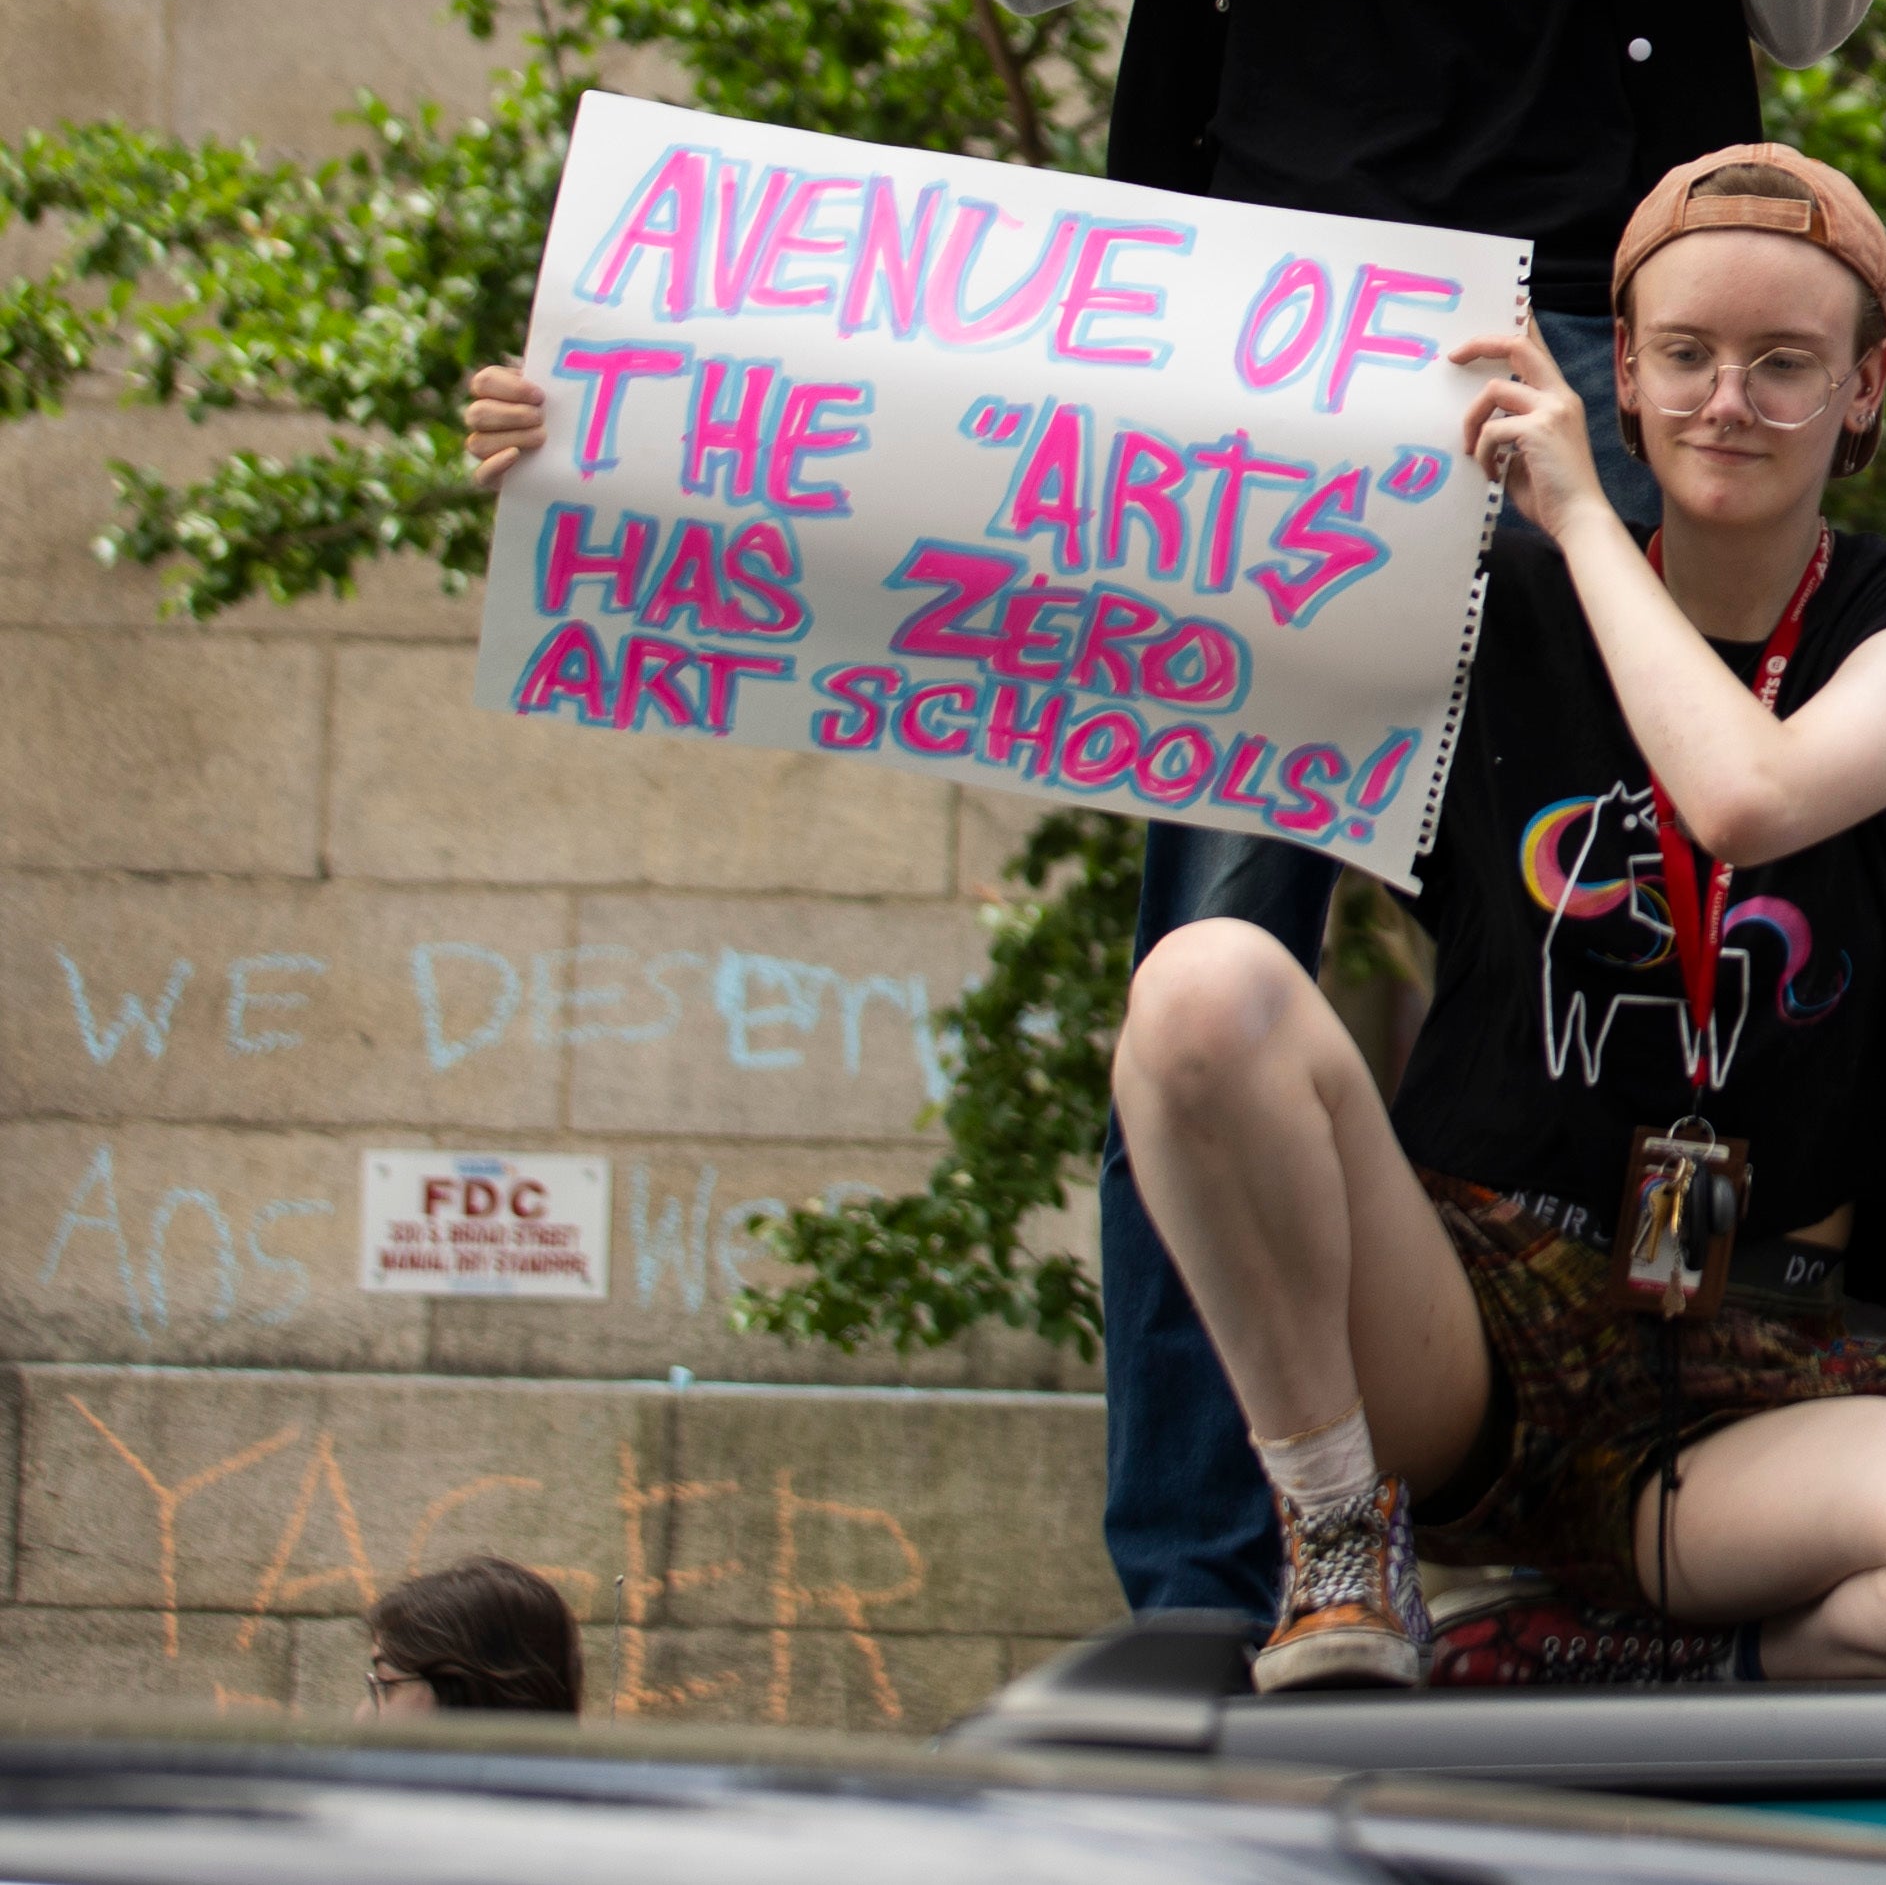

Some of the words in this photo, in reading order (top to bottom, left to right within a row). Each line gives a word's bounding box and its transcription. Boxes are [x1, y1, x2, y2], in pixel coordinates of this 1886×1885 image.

[574, 141, 1198, 372] AVENUE
[1233, 252, 1465, 414] OF
[553, 337, 876, 519] THE
[533, 500, 811, 643] HAS
[885, 535, 1253, 713] ZERO
[513, 617, 800, 738] ART
[809, 661, 1423, 847] SCHOOLS!
[53, 942, 330, 1066] WE
[422, 1176, 549, 1218] FDC
